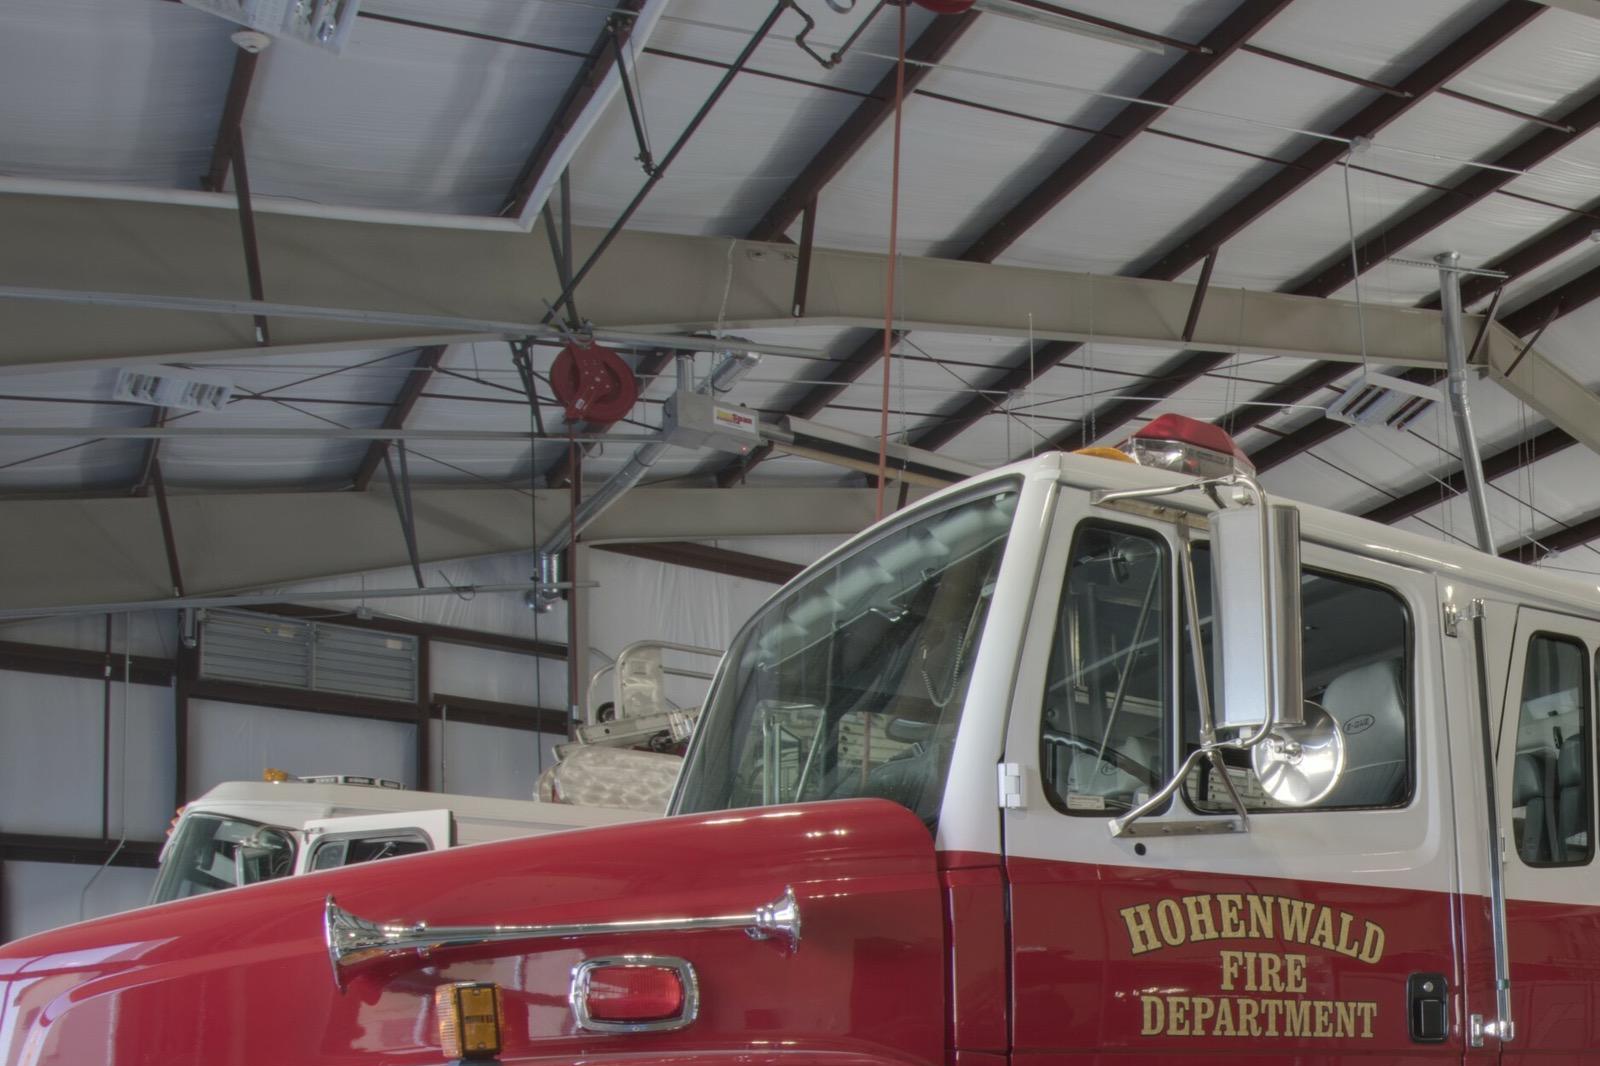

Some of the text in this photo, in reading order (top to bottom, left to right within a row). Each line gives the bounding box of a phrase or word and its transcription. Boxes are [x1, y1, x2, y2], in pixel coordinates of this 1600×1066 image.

[1119, 894, 1386, 964] HOHENWALD
[1219, 950, 1307, 993] FIRE
[1140, 995, 1378, 1038] DEPARTMENT
